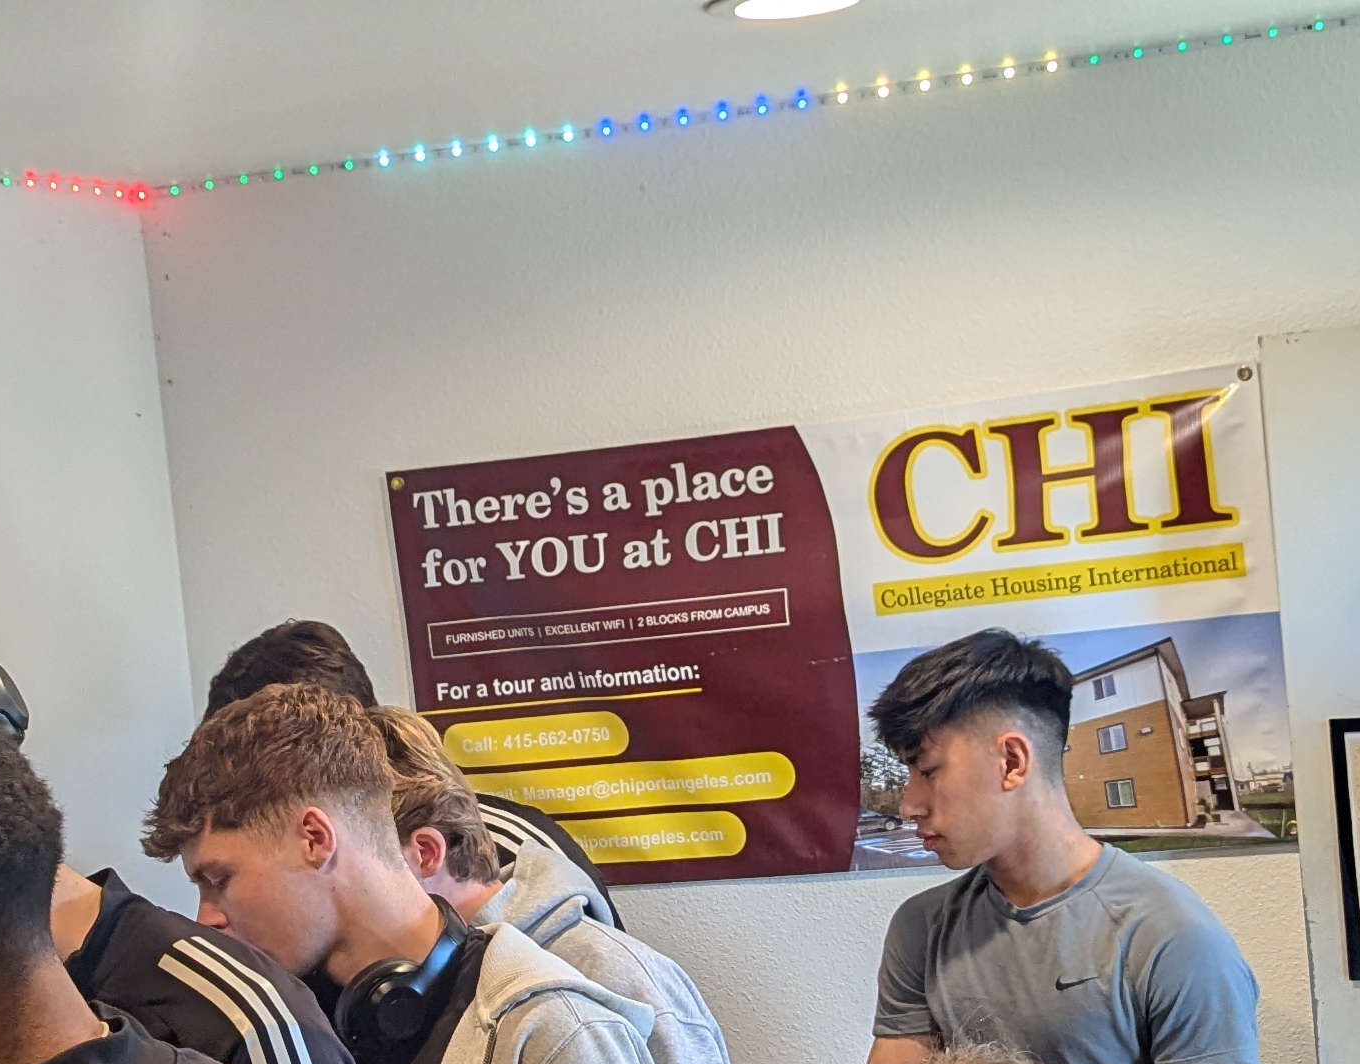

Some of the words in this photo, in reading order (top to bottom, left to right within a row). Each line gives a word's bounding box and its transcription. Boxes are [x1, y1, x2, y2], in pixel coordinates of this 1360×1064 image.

[413, 477, 589, 529] There’s
[602, 483, 630, 511] a
[643, 463, 774, 517] place
[871, 389, 1237, 562] CHI
[422, 549, 486, 588] for
[495, 533, 608, 580] YOU
[622, 530, 671, 569] at
[685, 513, 786, 562] CHI
[880, 576, 985, 609] Collegiate
[991, 570, 1081, 598] Housing
[1088, 552, 1237, 588] International
[445, 628, 505, 645] FURNISHED
[507, 626, 535, 639] UNITS
[544, 621, 601, 637] EXCELLENT
[602, 618, 625, 632] WIFI
[637, 616, 645, 627] 2
[646, 611, 690, 627] BLOCKS
[691, 607, 723, 622] FROM
[724, 602, 771, 619] CAMPUS
[437, 681, 470, 702] For
[476, 682, 489, 698] a
[493, 676, 535, 697] tour
[540, 671, 575, 693] and
[579, 663, 701, 688] information:
[462, 736, 498, 754] Call:
[503, 727, 610, 750] 415-662-0750
[523, 769, 772, 802] Manager@chiportangeles.com
